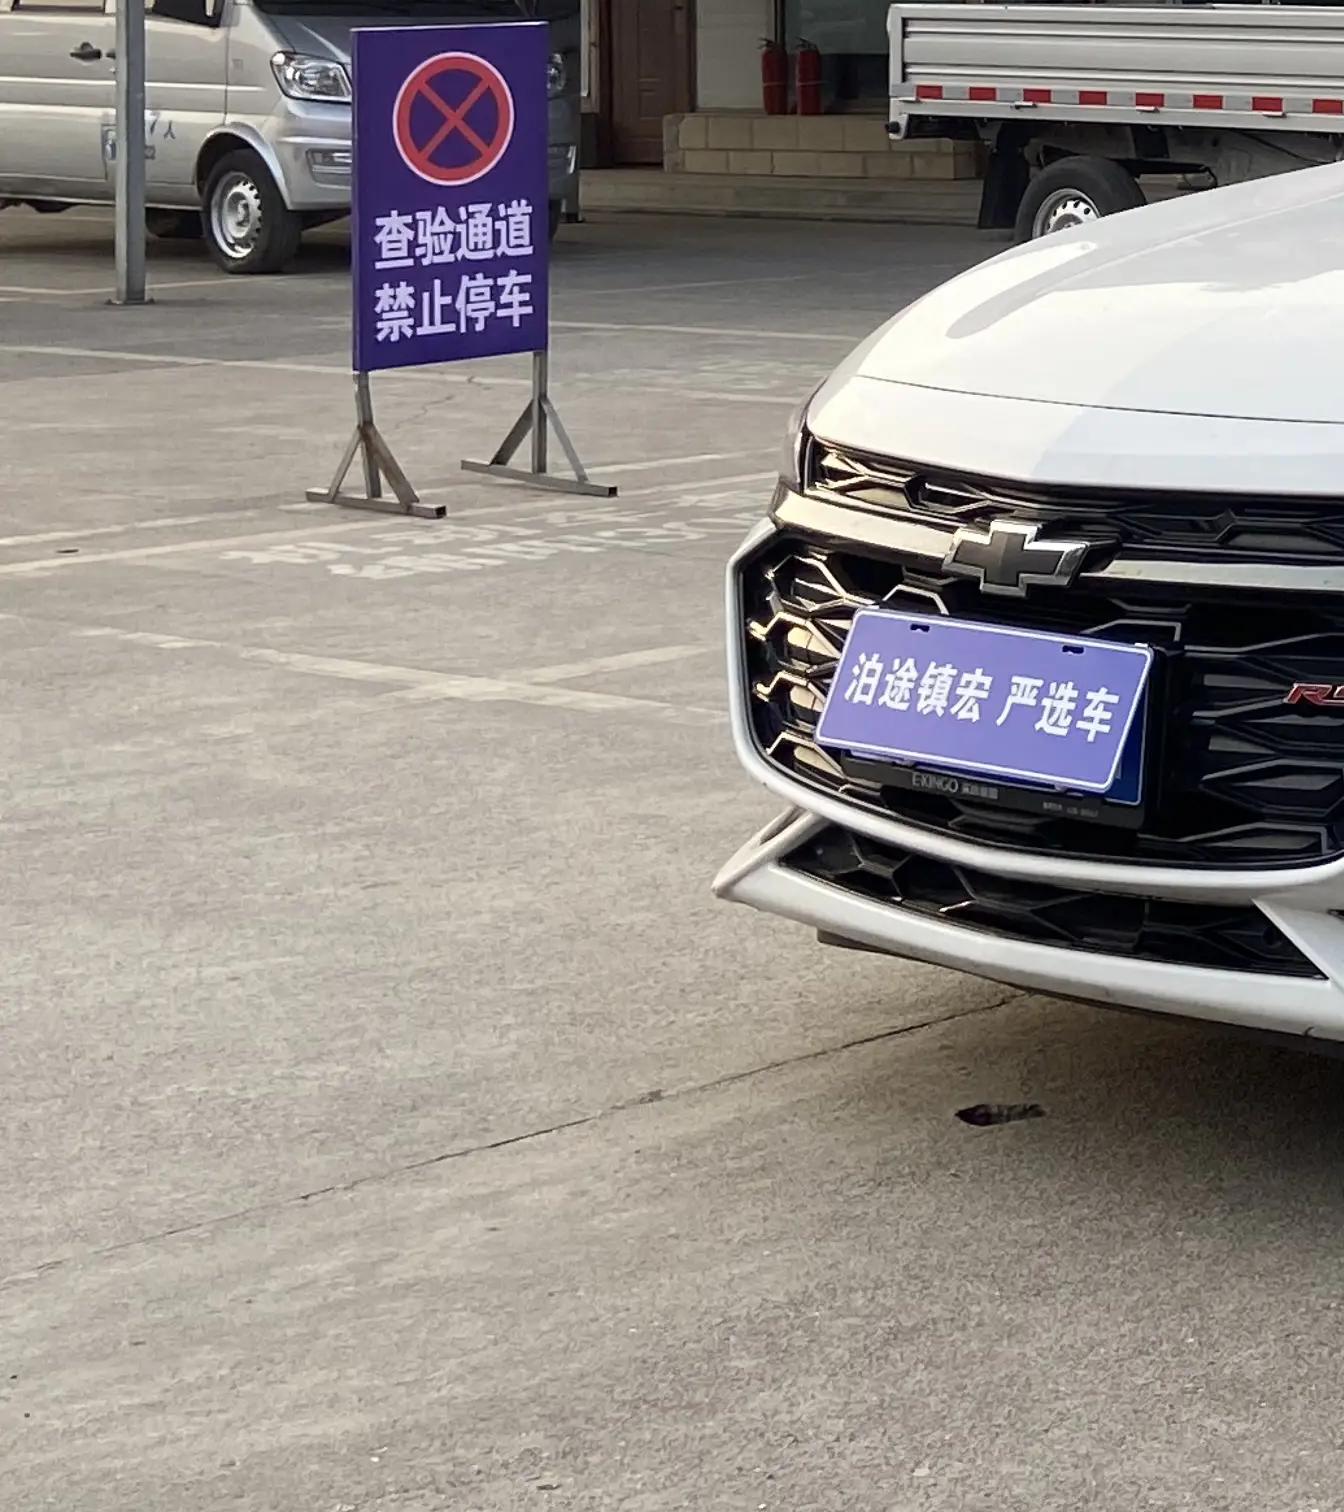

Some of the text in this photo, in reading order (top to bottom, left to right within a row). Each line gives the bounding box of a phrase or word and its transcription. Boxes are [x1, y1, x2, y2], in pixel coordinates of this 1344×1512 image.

[373, 198, 534, 270] 查验通道
[373, 269, 534, 344] 禁止停车
[844, 651, 1120, 744] 泊途镇宏 严选车
